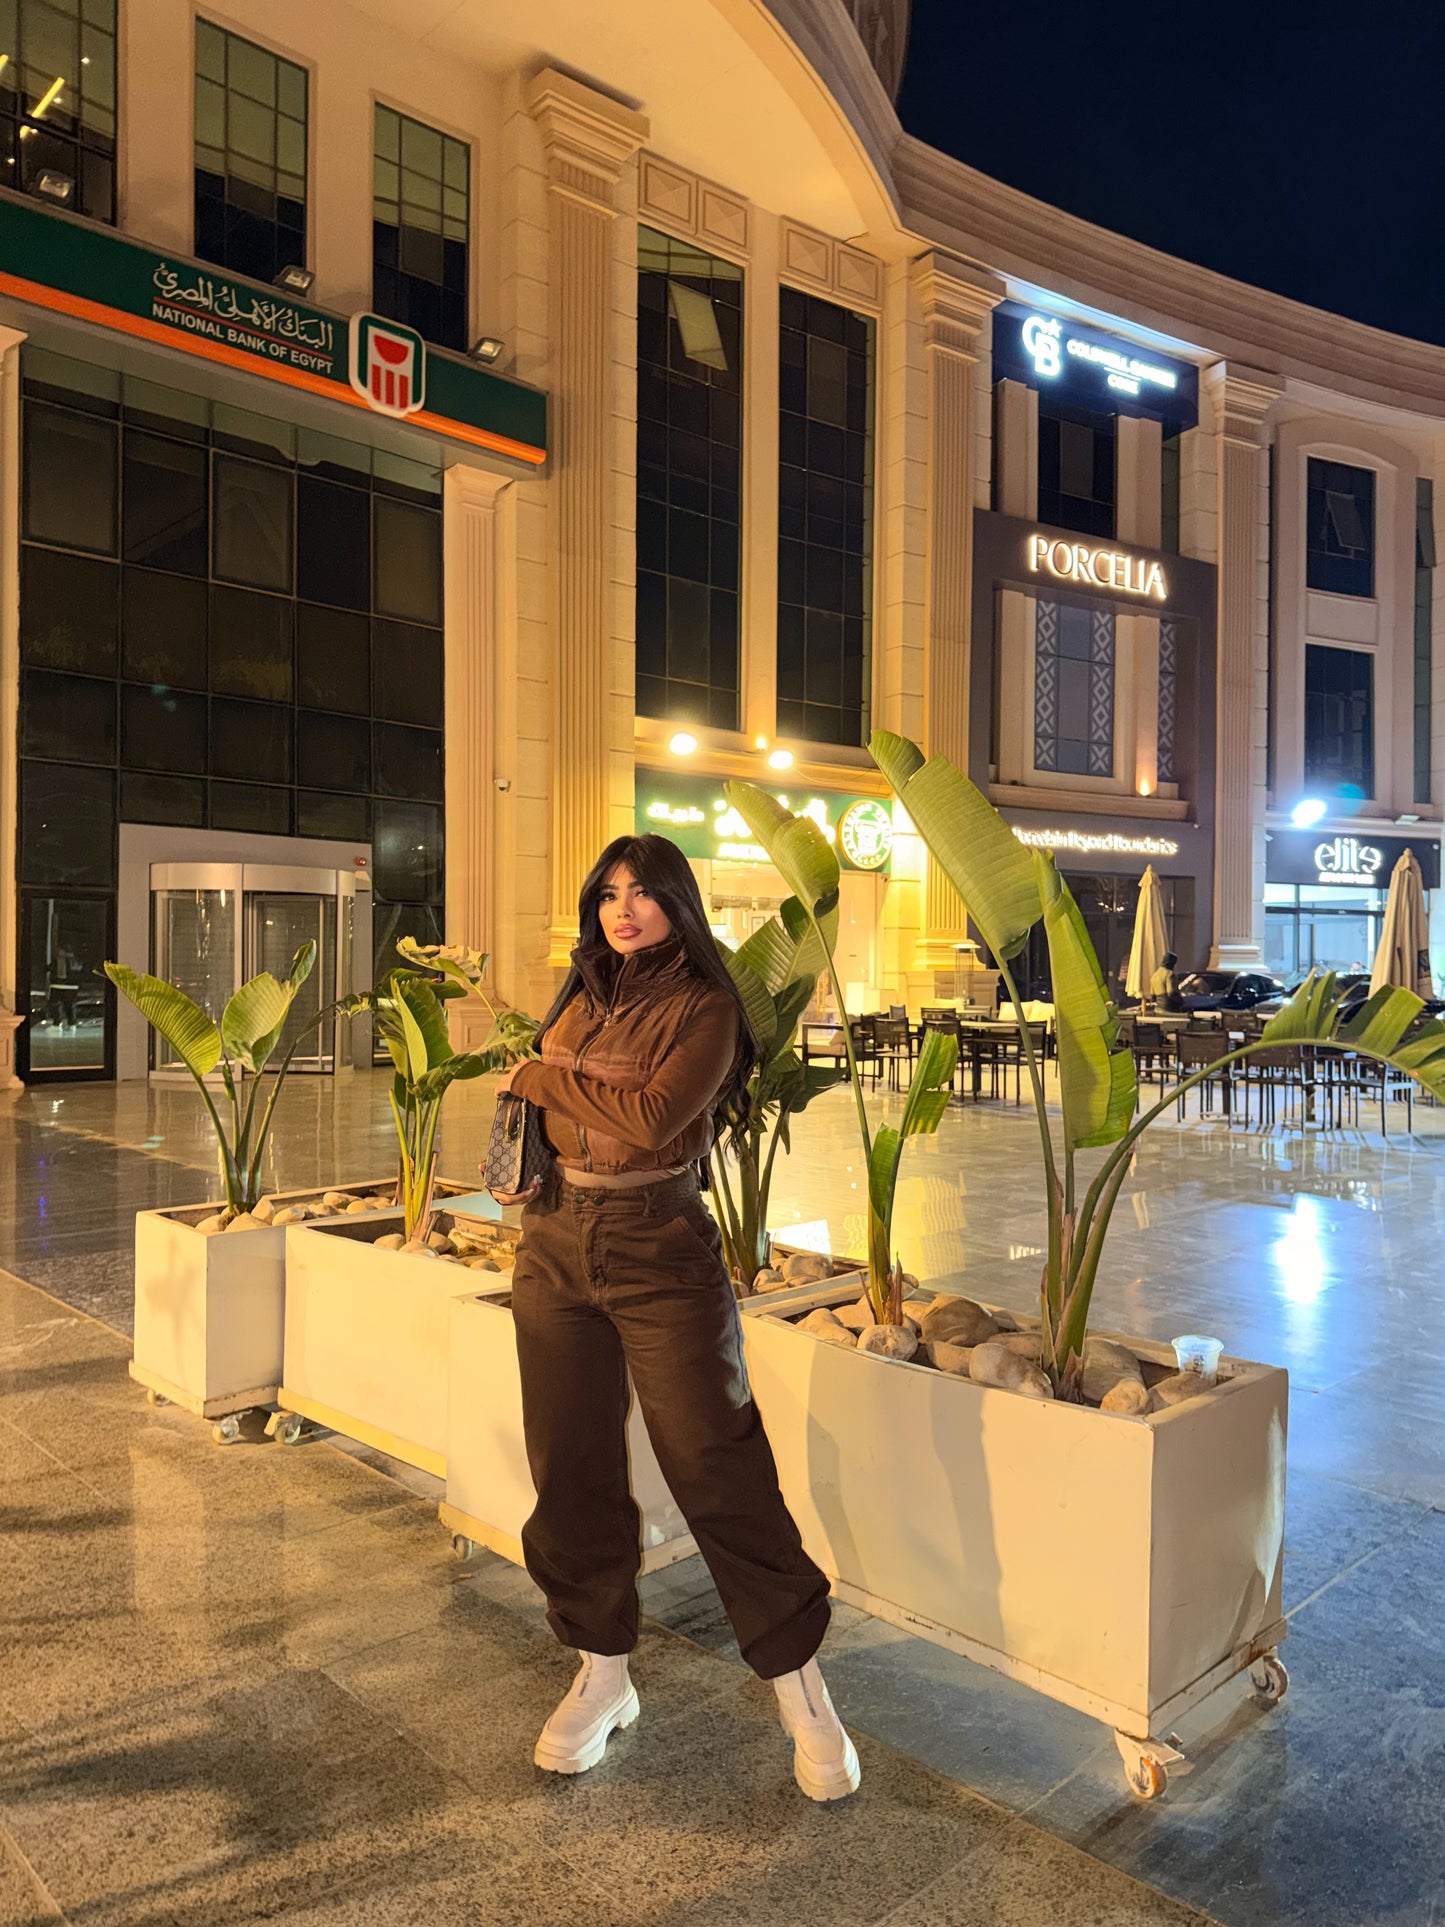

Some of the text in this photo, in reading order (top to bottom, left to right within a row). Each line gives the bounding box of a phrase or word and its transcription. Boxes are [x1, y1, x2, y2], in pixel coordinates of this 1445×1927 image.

[152, 303, 333, 374] NATIONAL BANK OF EGYPT
[1029, 535, 1167, 599] PORCELIA
